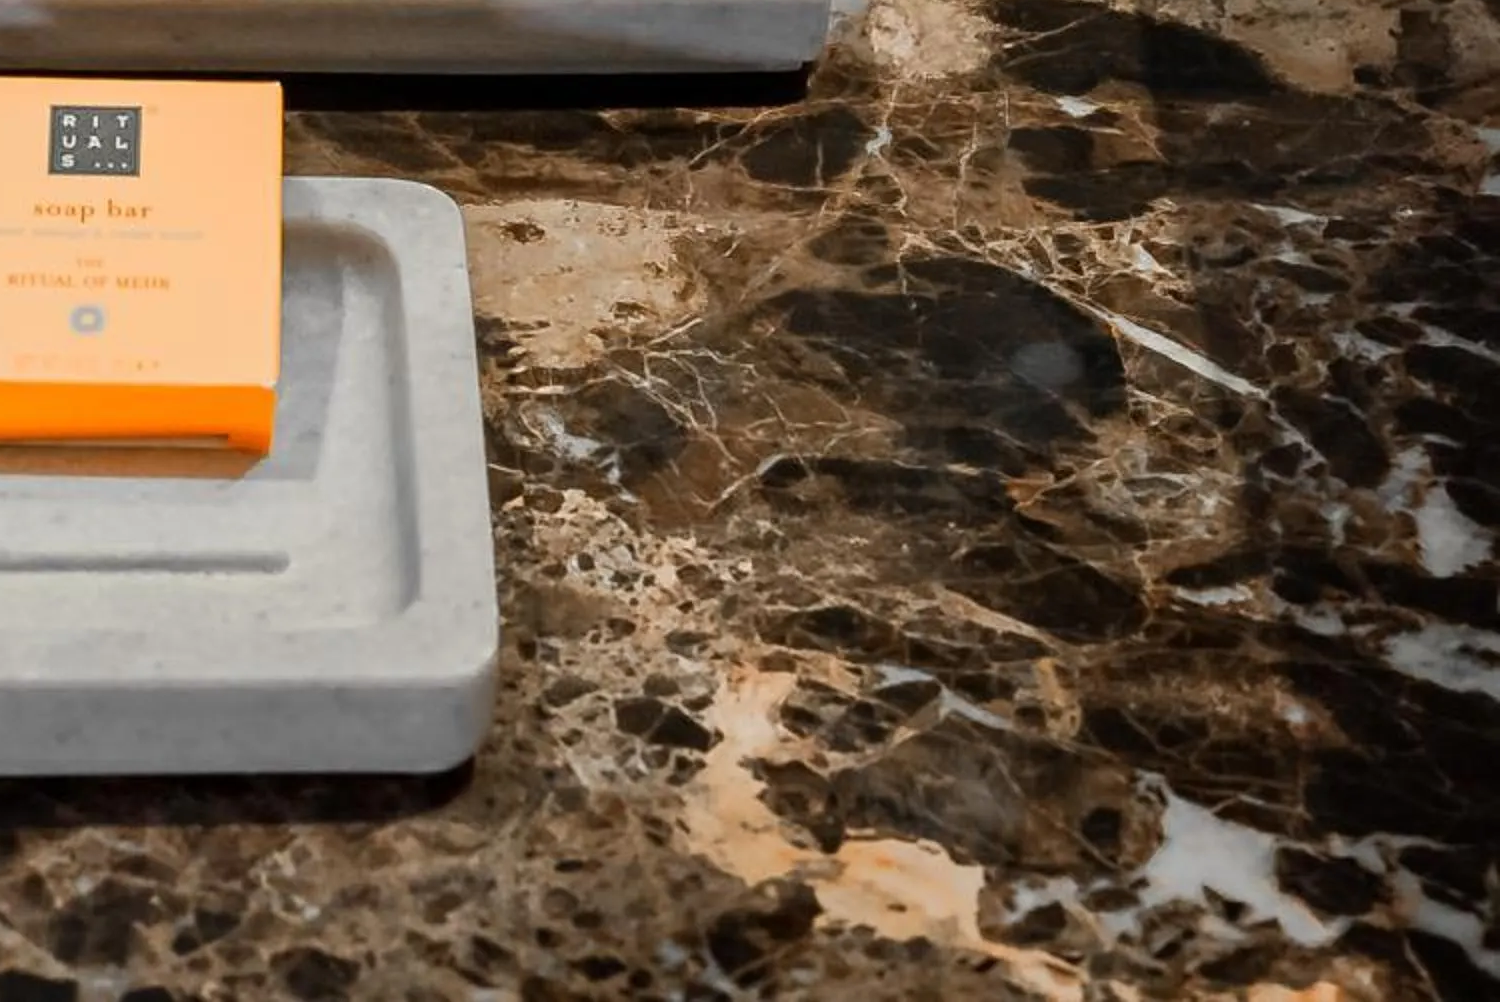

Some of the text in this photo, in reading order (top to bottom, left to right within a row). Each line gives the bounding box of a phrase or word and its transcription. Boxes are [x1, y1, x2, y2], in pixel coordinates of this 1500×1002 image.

[32, 198, 154, 223] soap bar
[6, 273, 76, 289] RITUAL
[82, 275, 109, 289] OF
